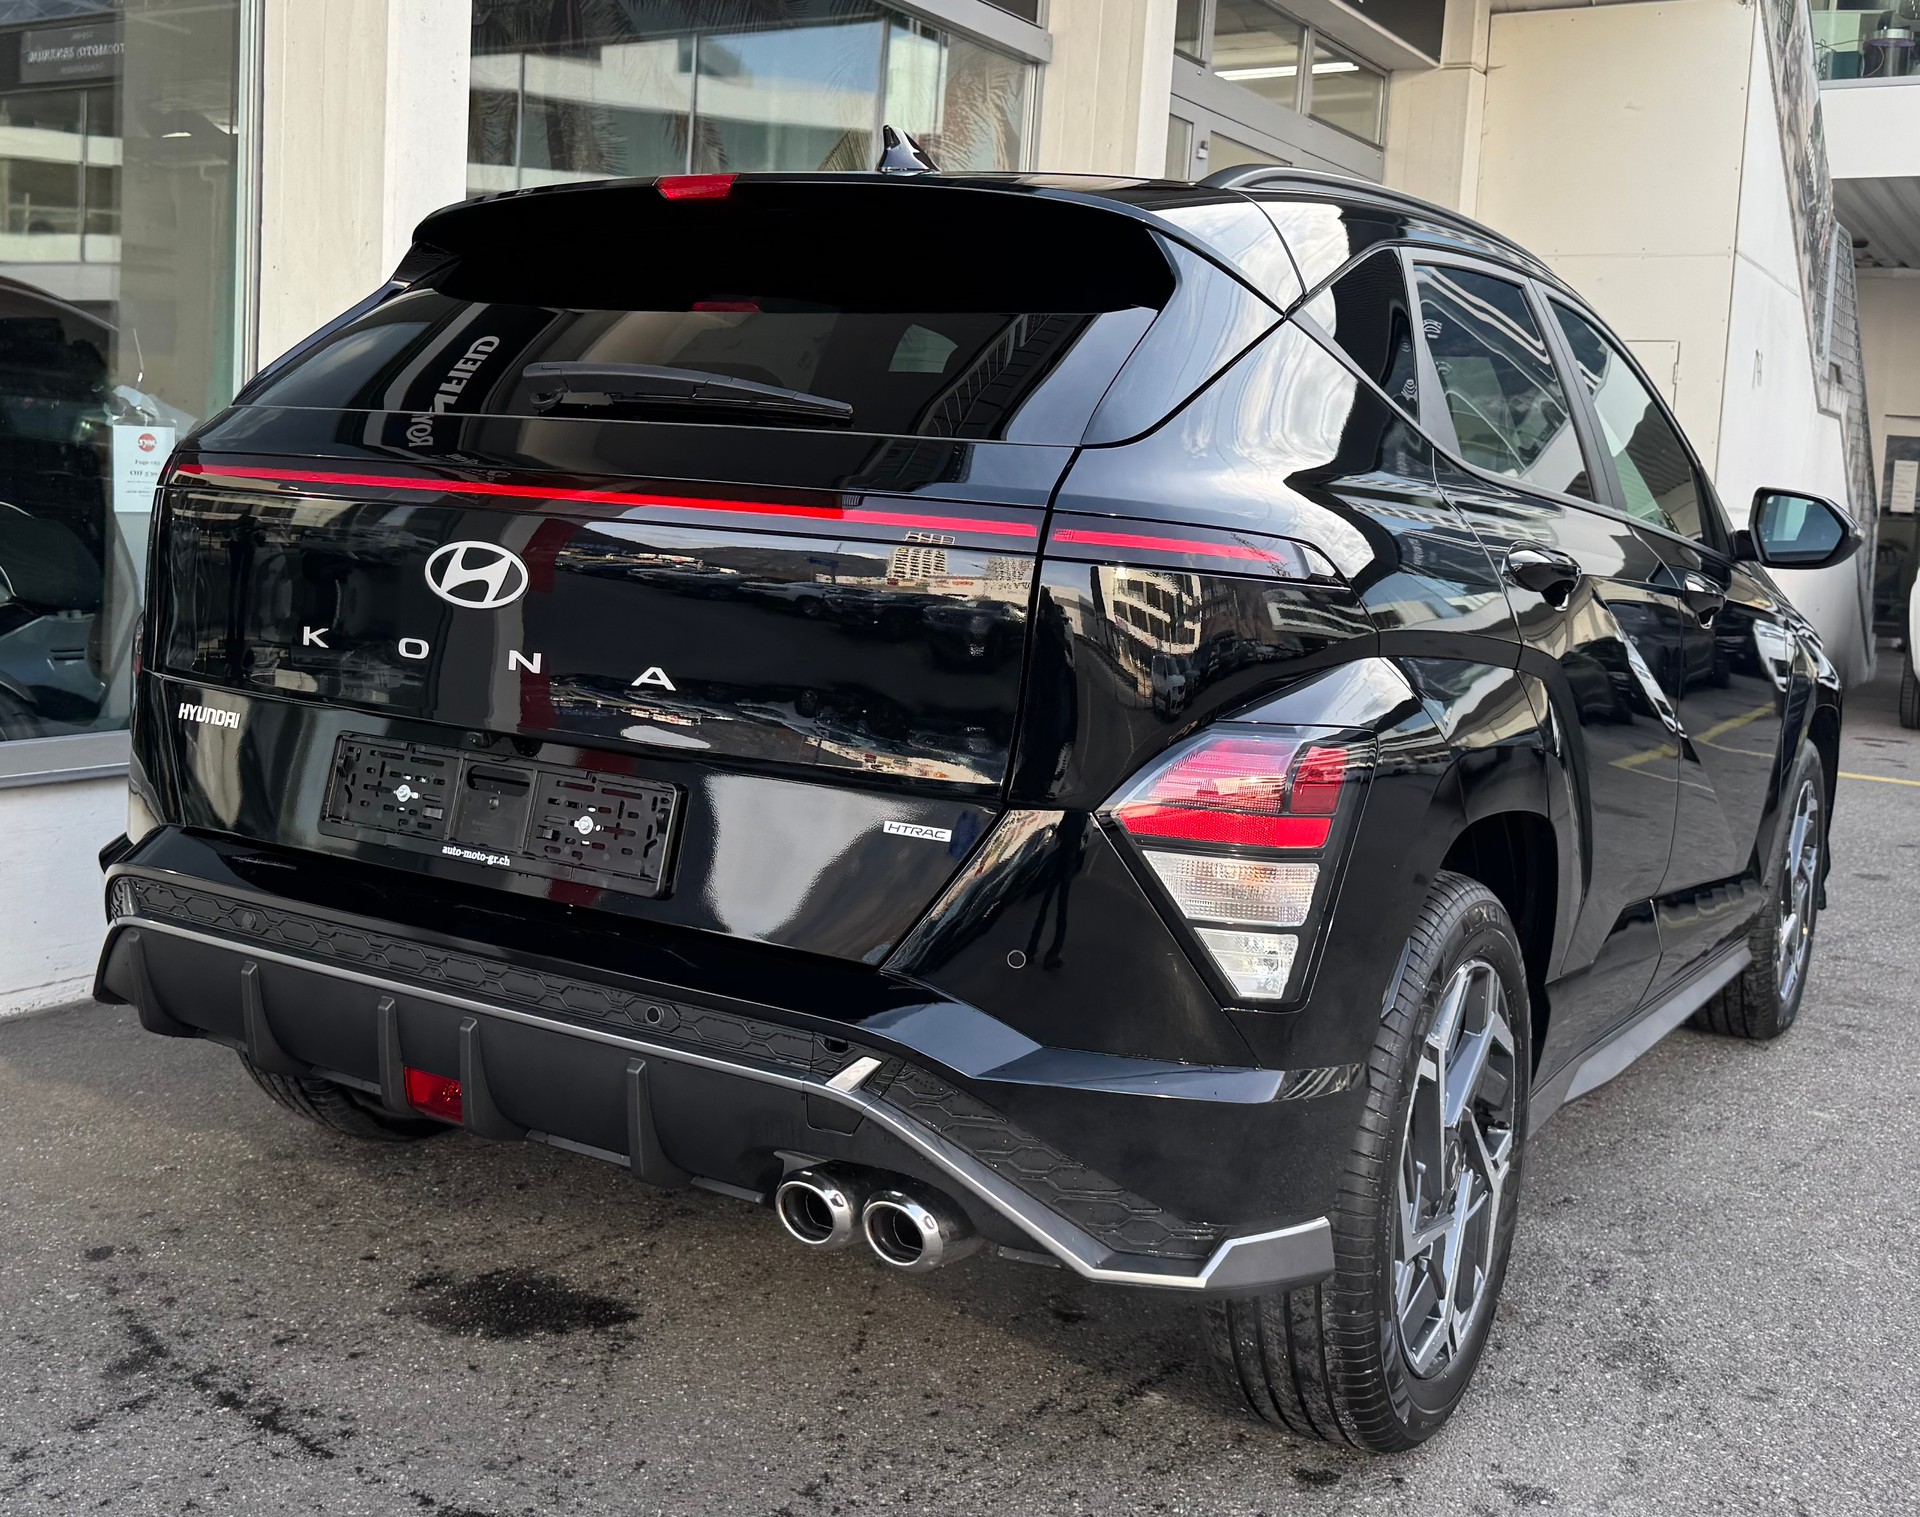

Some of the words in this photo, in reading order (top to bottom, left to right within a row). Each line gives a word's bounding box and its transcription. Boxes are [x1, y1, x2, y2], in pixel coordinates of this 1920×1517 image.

[302, 626, 676, 691] KONA
[178, 702, 240, 729] HYUNDAI
[888, 823, 947, 840] HTRAC
[442, 845, 511, 867] auto-moto-gr.ch
